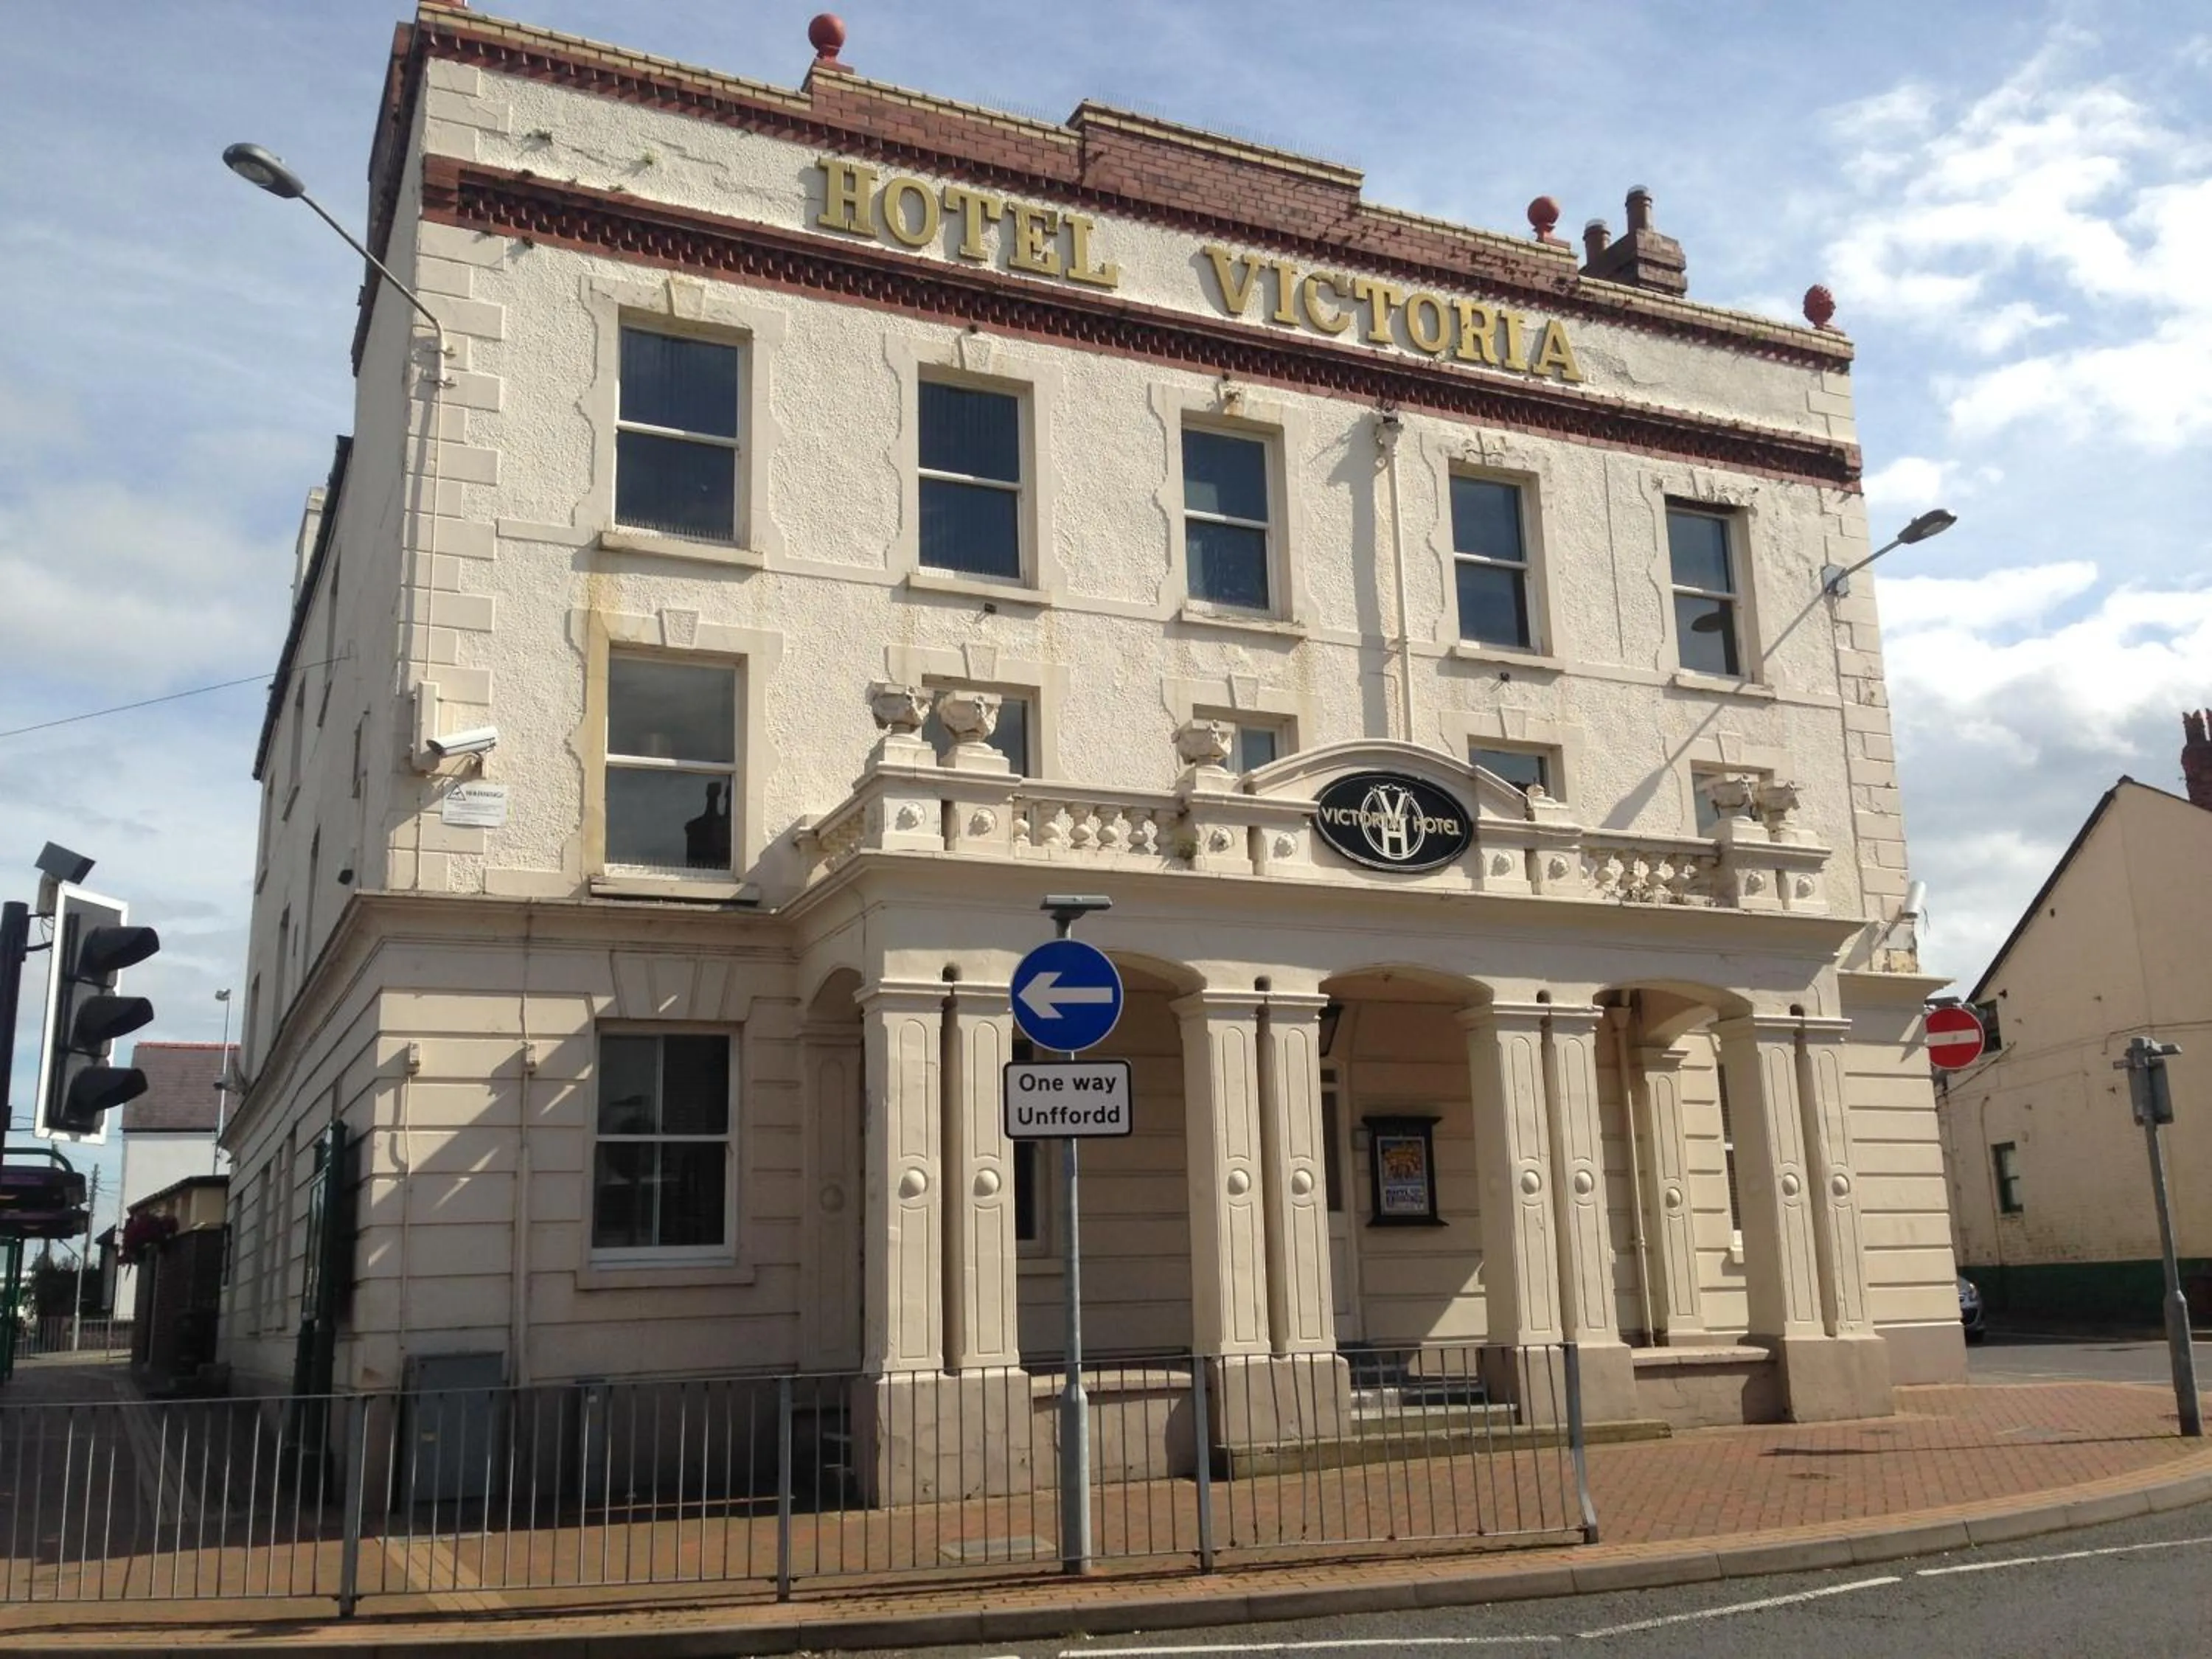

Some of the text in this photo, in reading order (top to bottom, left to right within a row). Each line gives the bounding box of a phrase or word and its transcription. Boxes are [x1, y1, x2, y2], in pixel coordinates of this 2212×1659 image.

[817, 156, 1585, 382] HOTEL VICTORIA
[1412, 816, 1462, 835] HOTEL
[1018, 1073, 1117, 1094] One way
[1018, 1105, 1121, 1125] Unffordd
